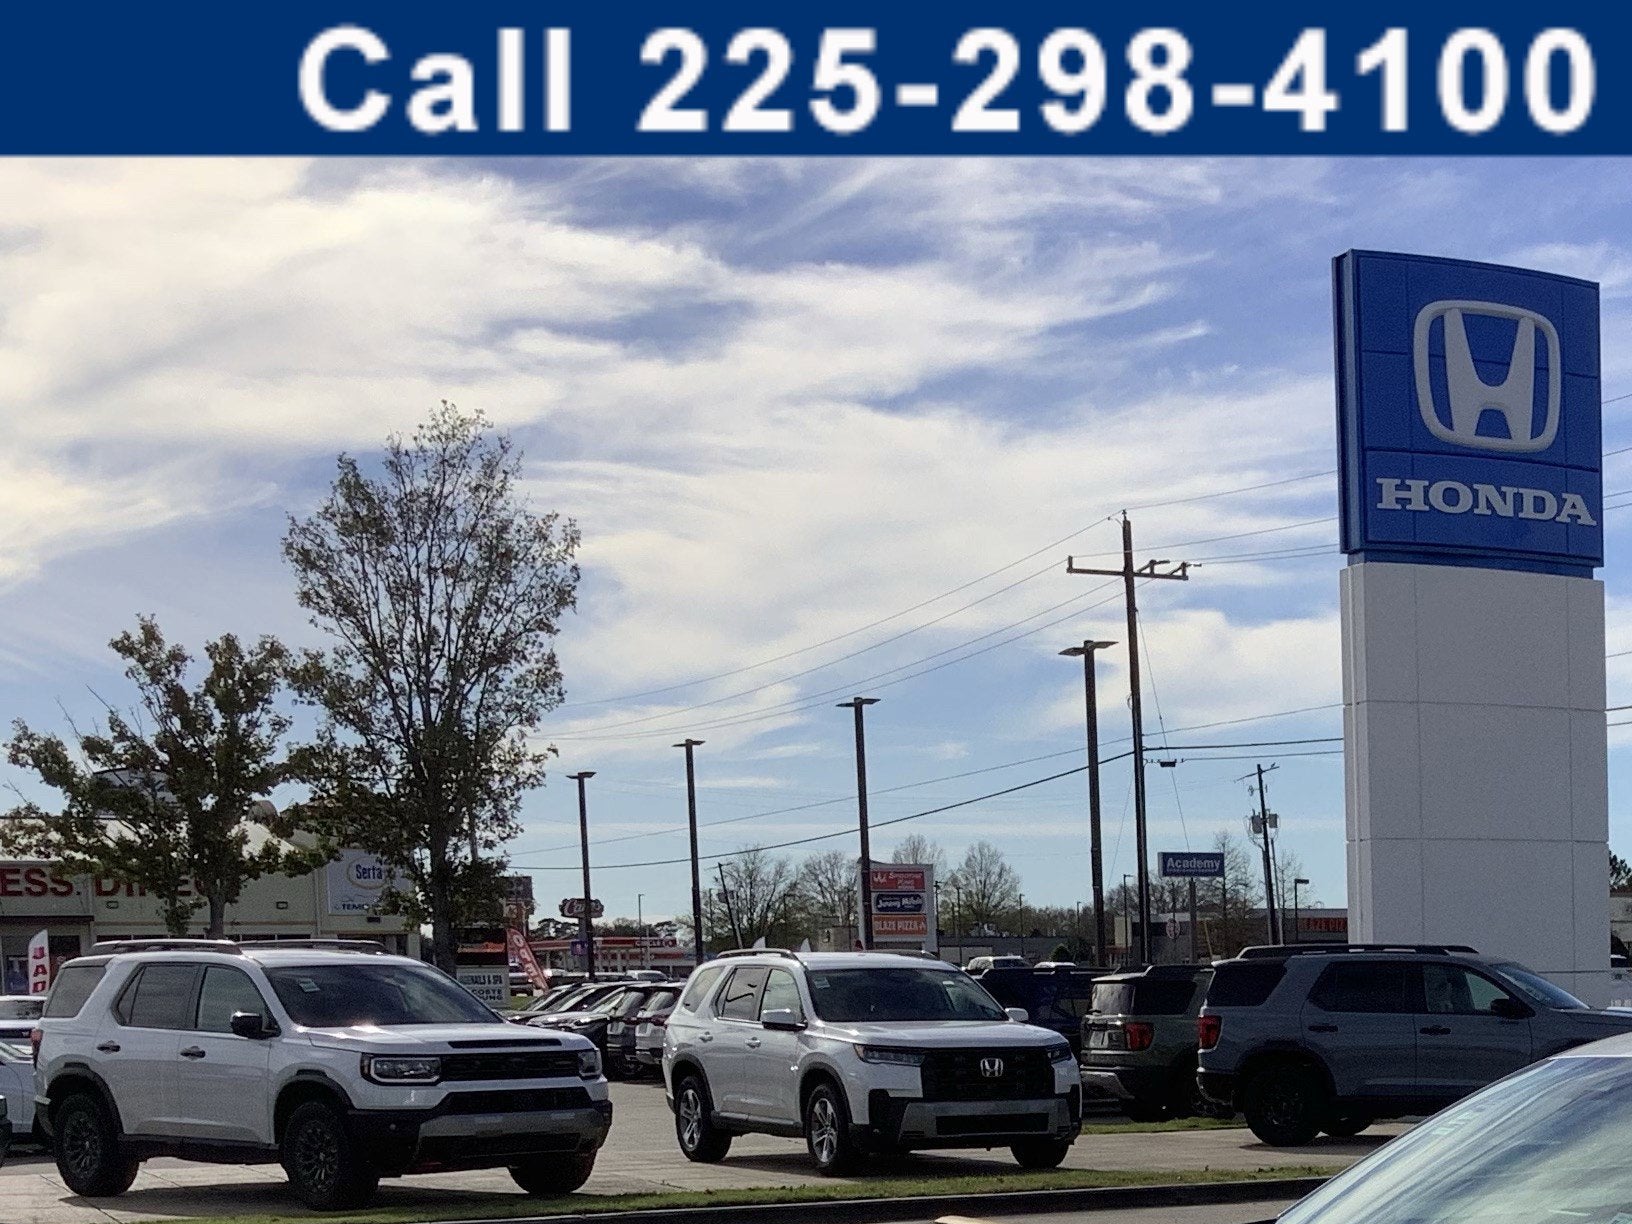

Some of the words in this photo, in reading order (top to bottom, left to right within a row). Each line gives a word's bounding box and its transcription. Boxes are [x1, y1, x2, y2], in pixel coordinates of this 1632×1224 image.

[1376, 477, 1597, 527] HONDA
[355, 864, 383, 880] Serta
[1166, 857, 1221, 873] Academy
